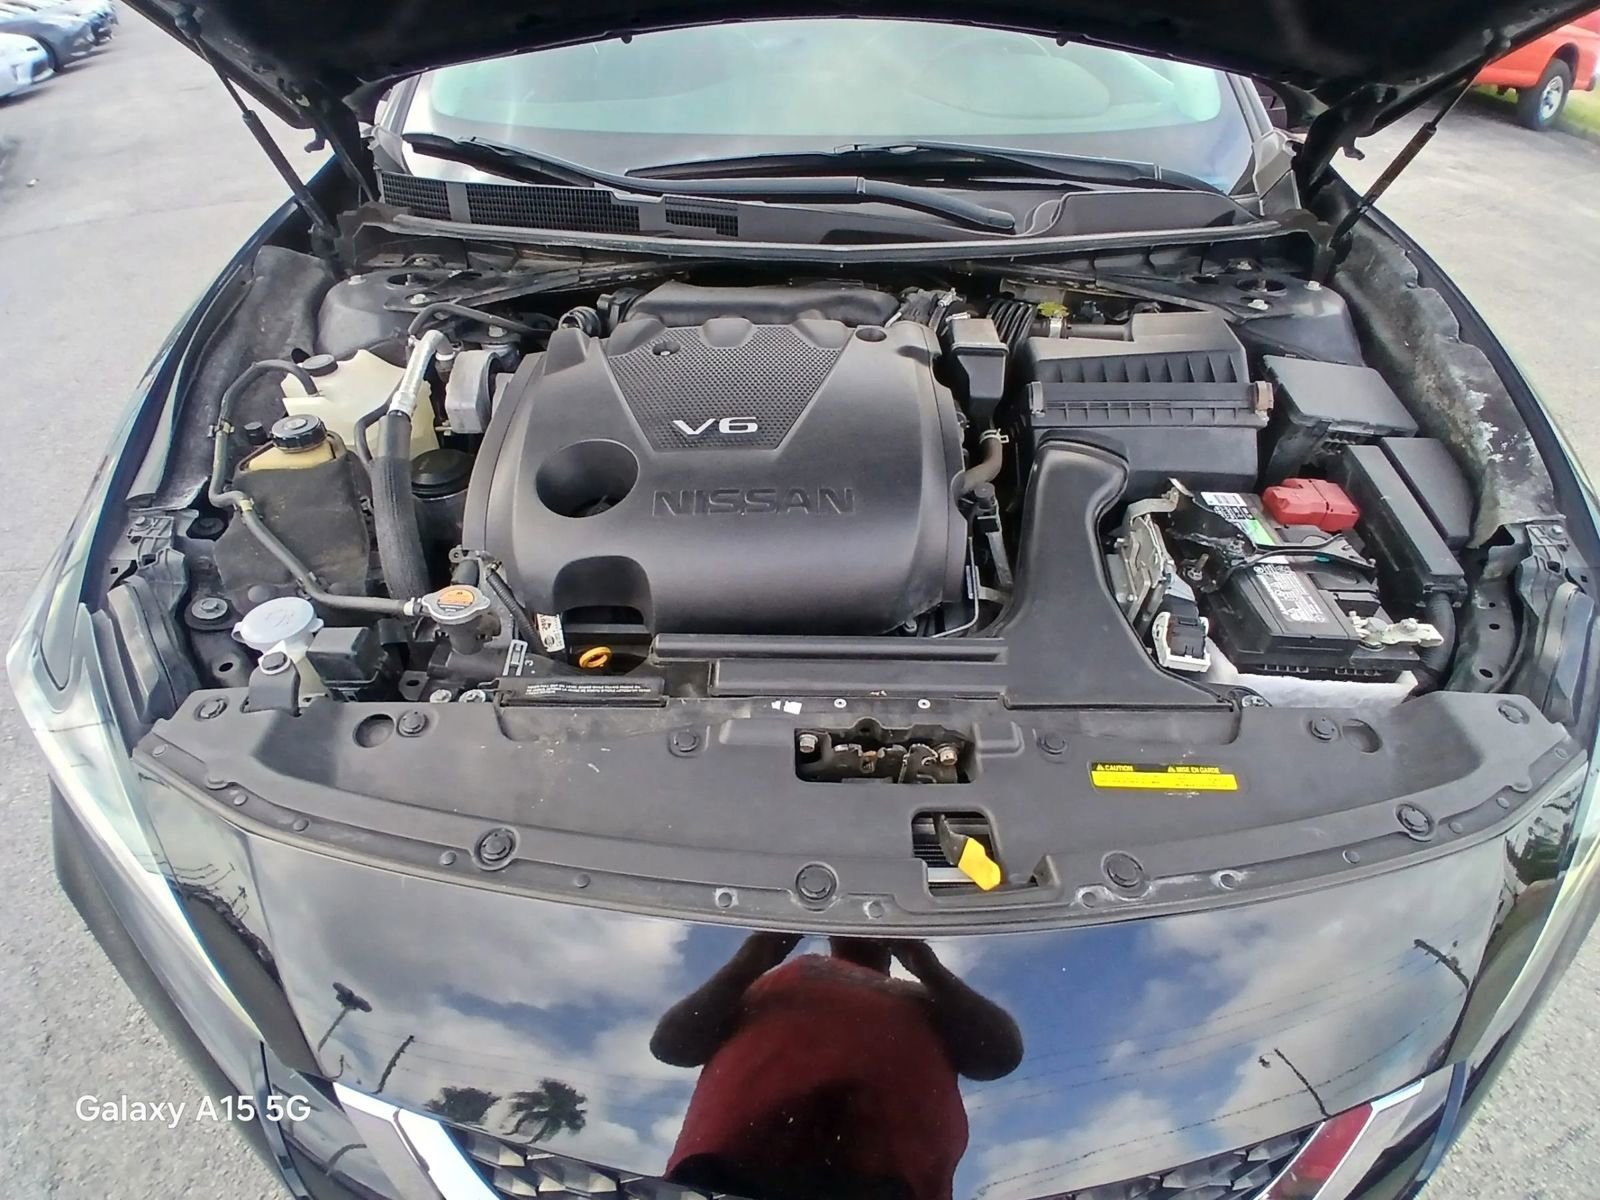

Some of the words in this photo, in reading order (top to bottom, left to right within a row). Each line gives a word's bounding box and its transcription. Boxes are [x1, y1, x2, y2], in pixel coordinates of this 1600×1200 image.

[673, 416, 758, 435] V6
[651, 487, 855, 516] NISSAN
[1104, 764, 1134, 772] CAUTION
